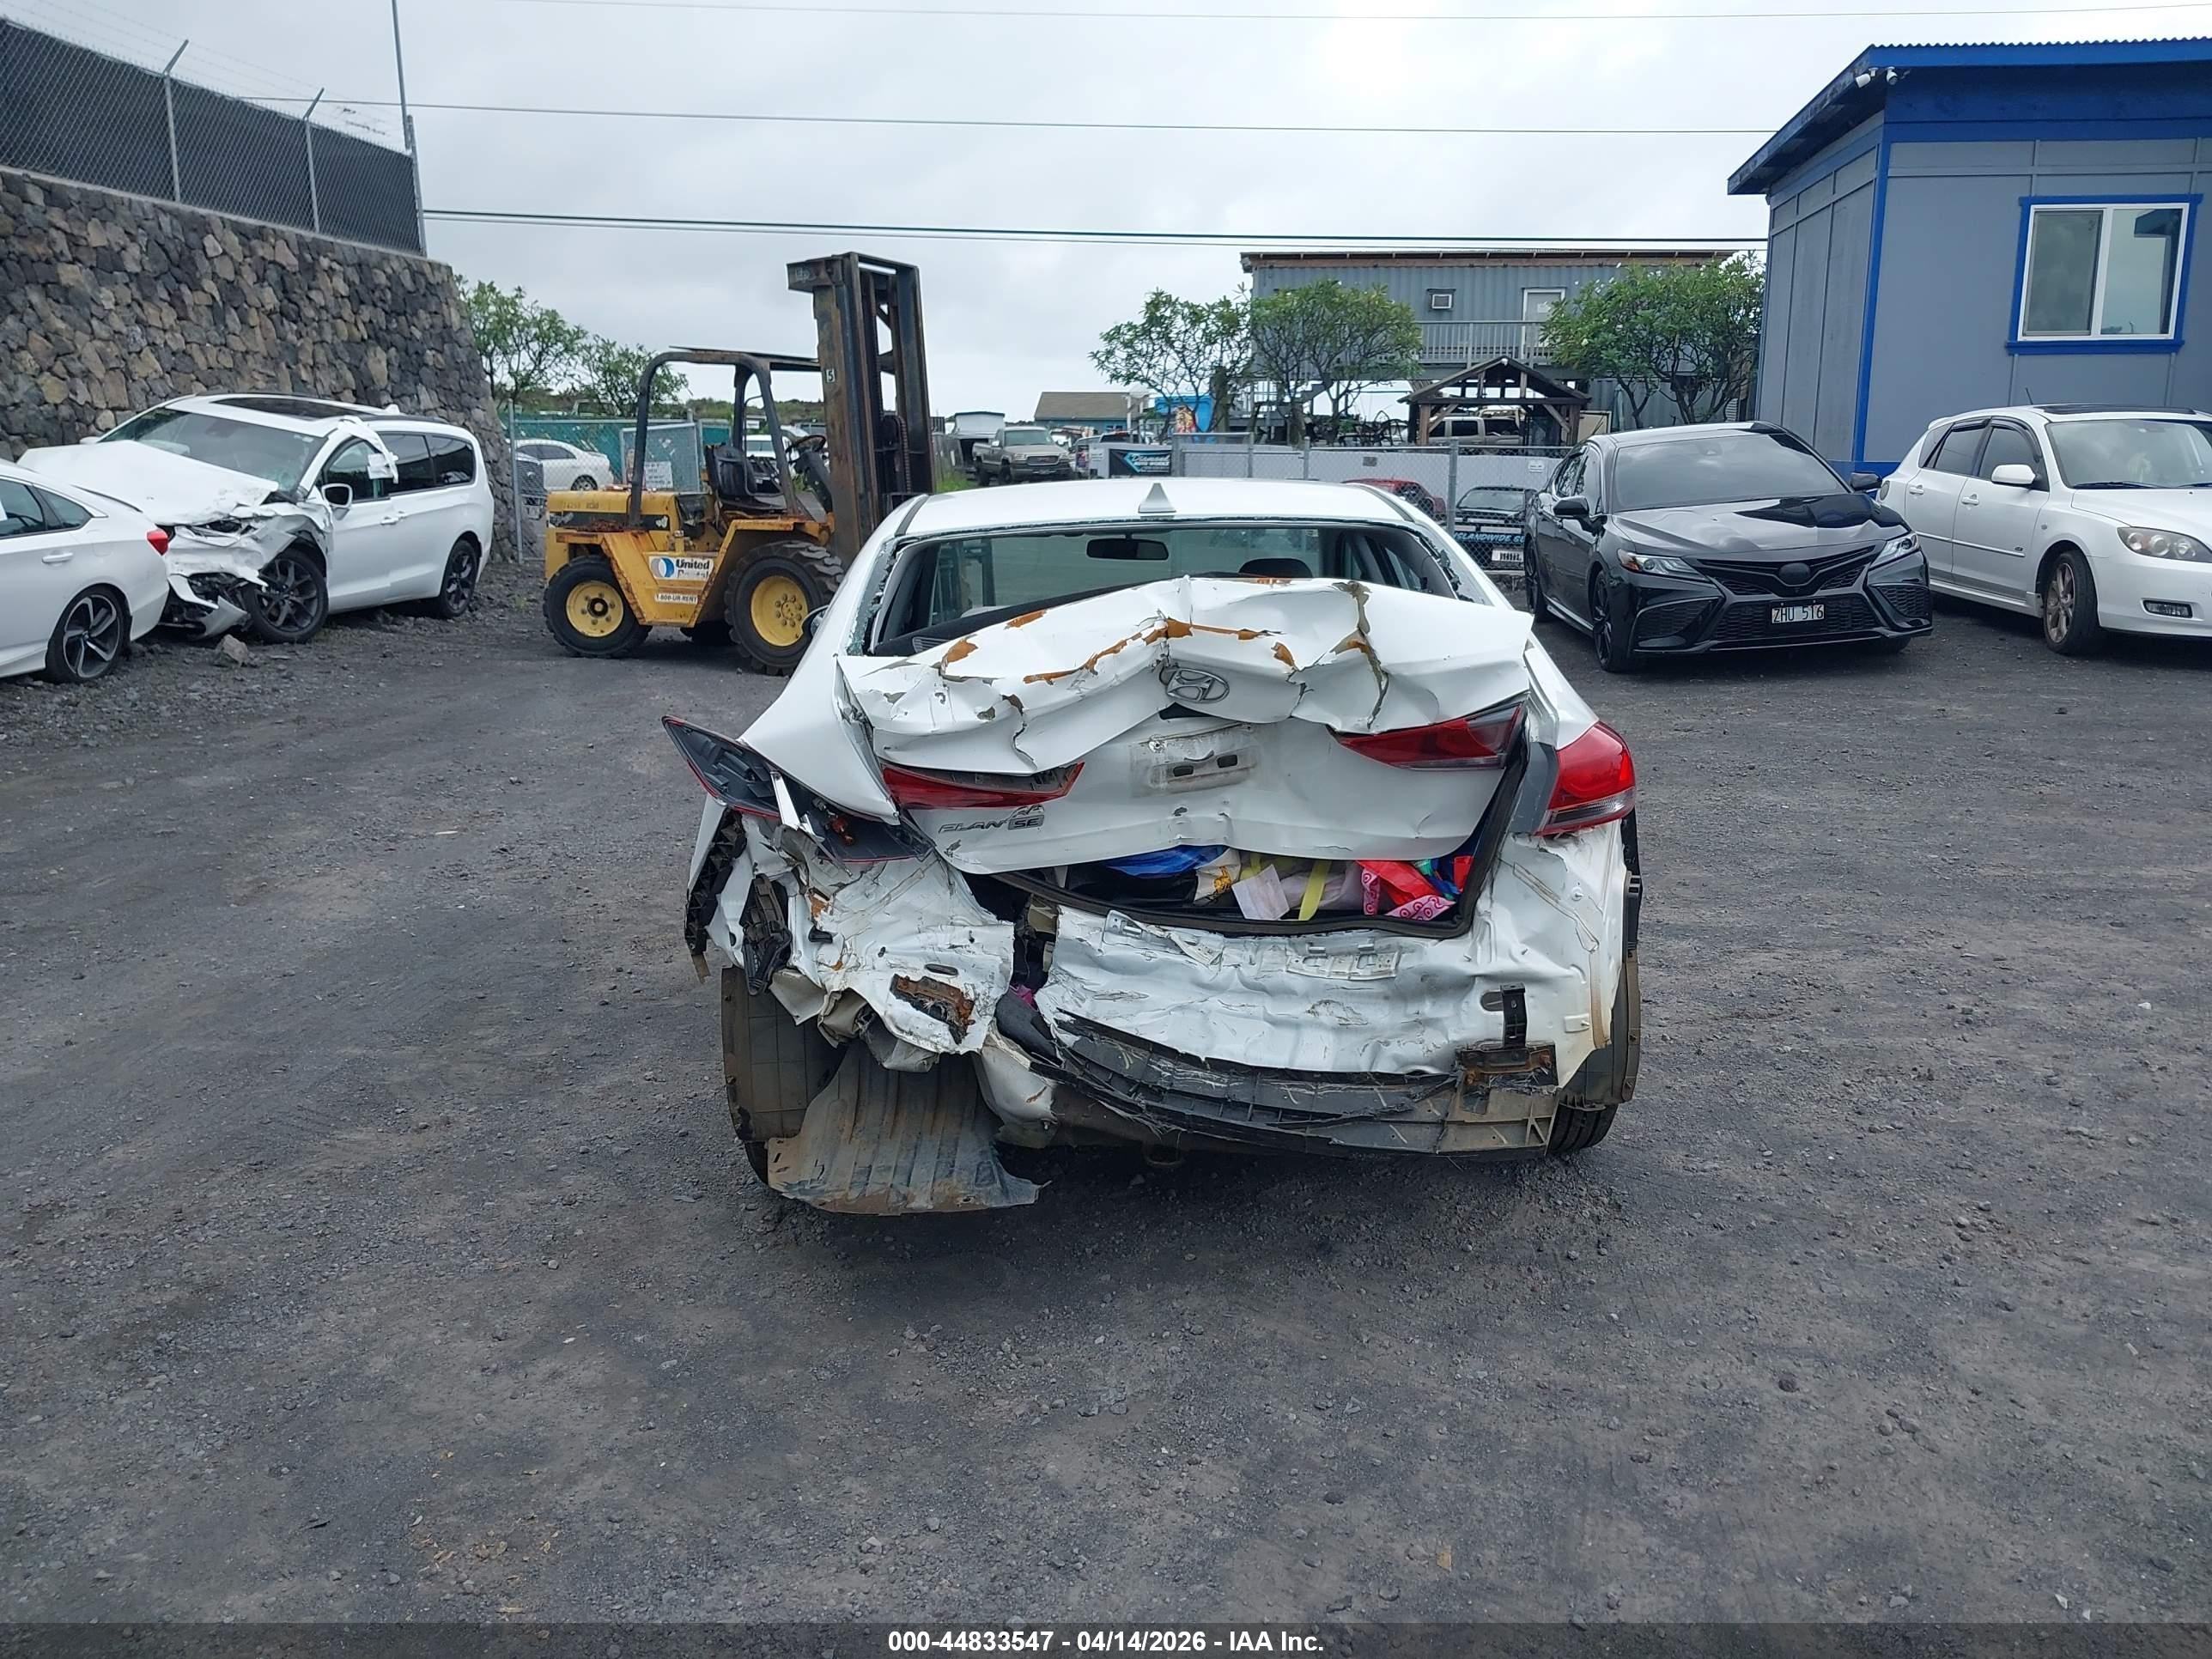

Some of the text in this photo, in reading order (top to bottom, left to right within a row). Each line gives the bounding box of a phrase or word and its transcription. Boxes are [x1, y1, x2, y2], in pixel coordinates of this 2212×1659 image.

[676, 558, 710, 570] United
[1773, 605, 1824, 623] ZHU 516
[1014, 817, 1040, 829] SE
